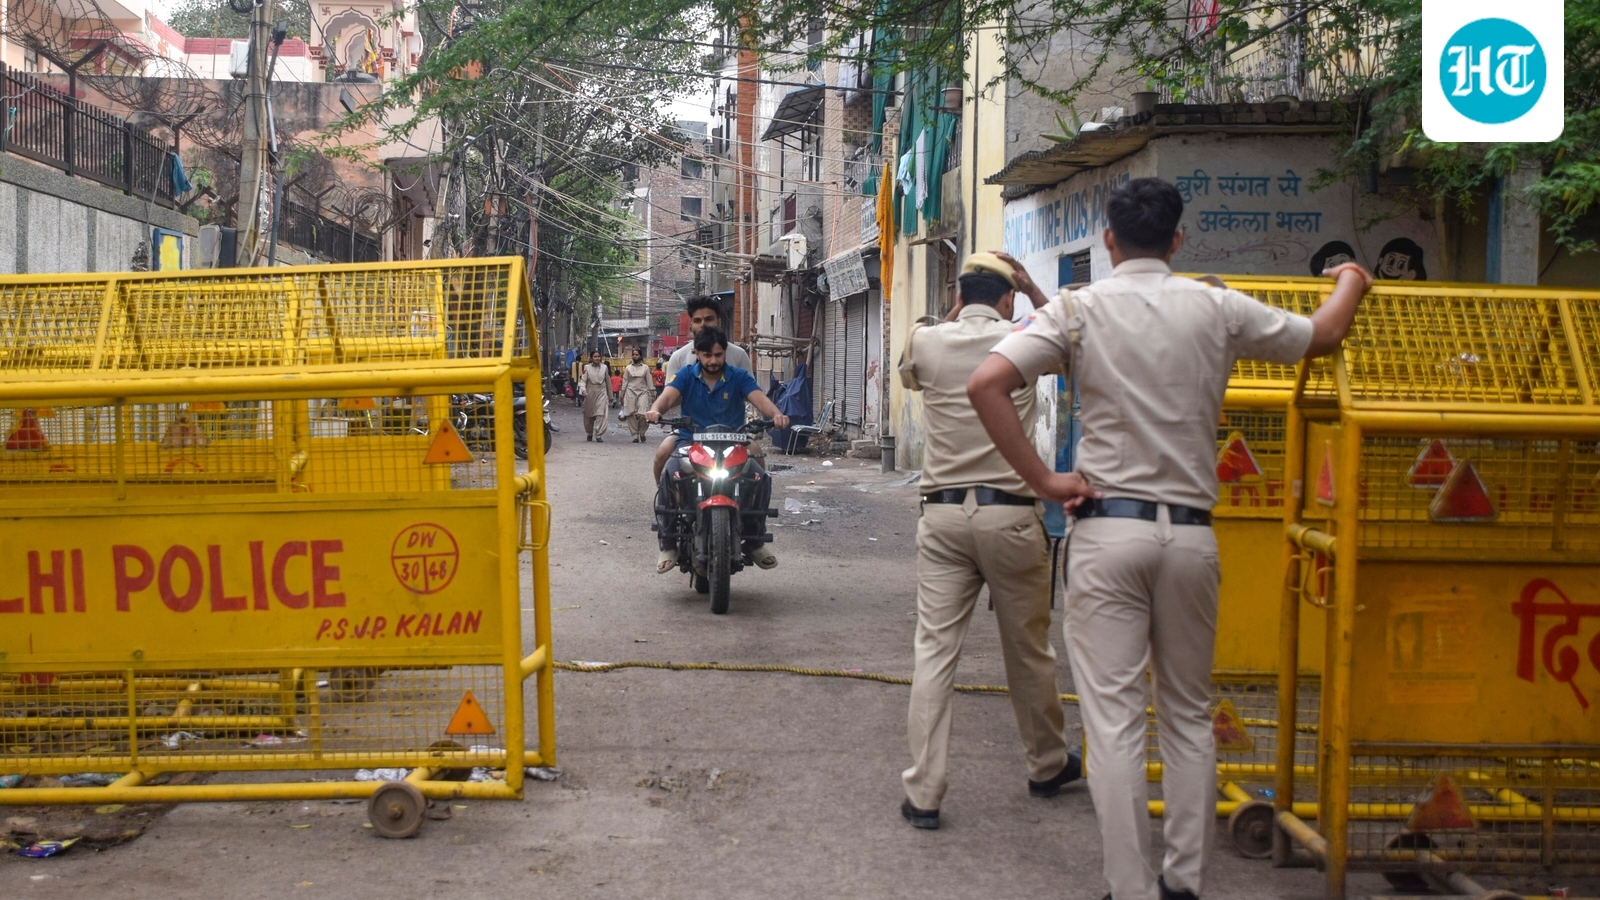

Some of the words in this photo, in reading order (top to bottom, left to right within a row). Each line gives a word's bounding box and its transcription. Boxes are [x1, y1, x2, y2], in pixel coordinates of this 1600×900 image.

[1175, 169, 1211, 203] बुरी
[1217, 172, 1270, 197] संगत
[1277, 169, 1301, 197] से
[1025, 199, 1061, 255] FUTURE
[1063, 188, 1088, 244] KIDS
[1197, 204, 1271, 233] अकेला
[1276, 211, 1322, 233] भला
[407, 531, 437, 548] DW
[111, 539, 346, 612] POLICE
[400, 561, 420, 581] 30
[429, 560, 447, 580] 48
[395, 609, 483, 638] KALAN
